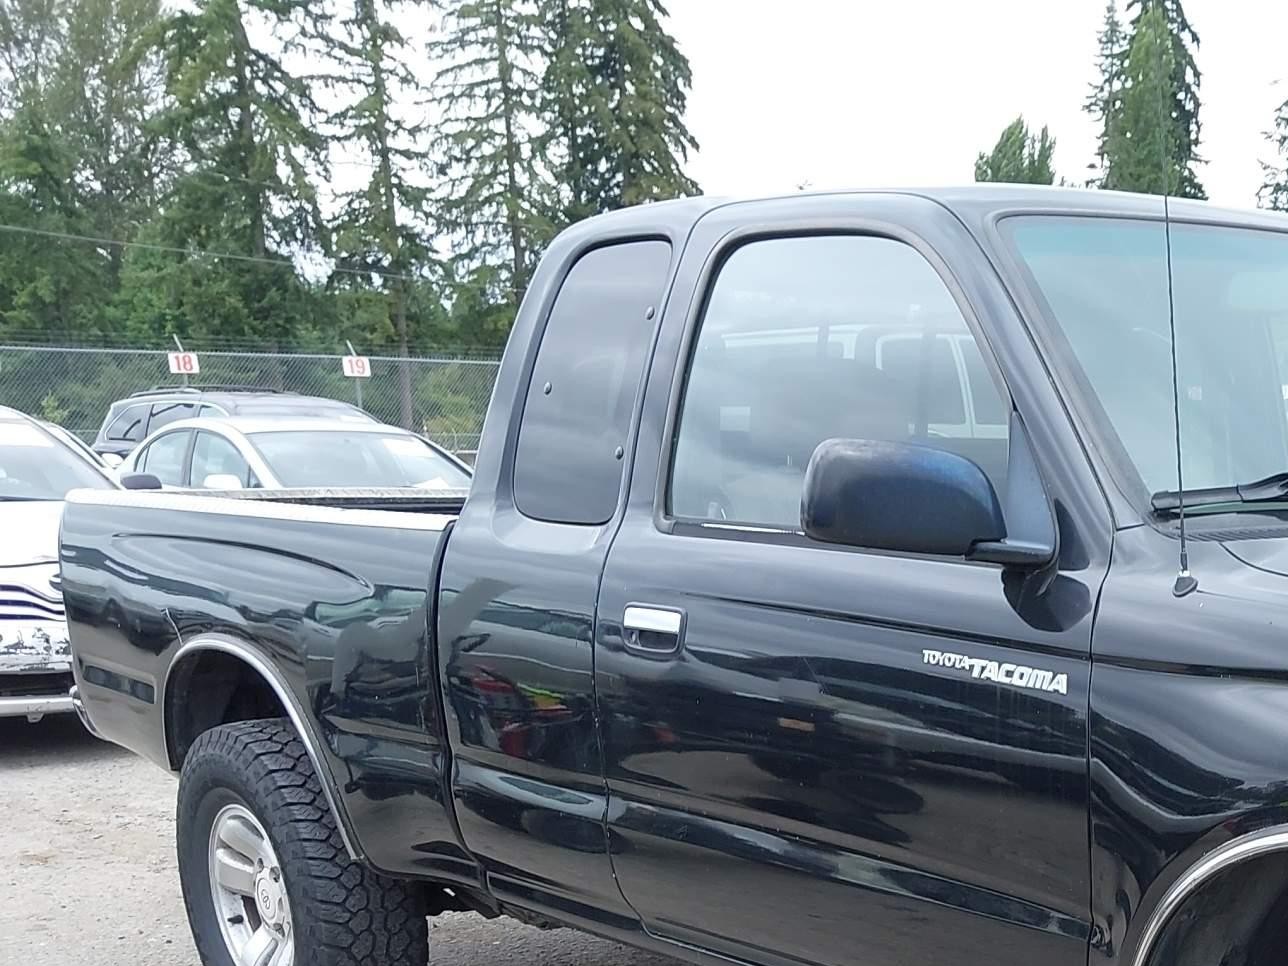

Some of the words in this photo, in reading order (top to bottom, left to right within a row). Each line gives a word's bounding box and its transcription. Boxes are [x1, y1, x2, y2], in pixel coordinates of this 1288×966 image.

[174, 354, 194, 372] 18
[348, 358, 366, 375] 19
[922, 649, 970, 671] TOYOTA
[967, 659, 1068, 694] TACOMA
